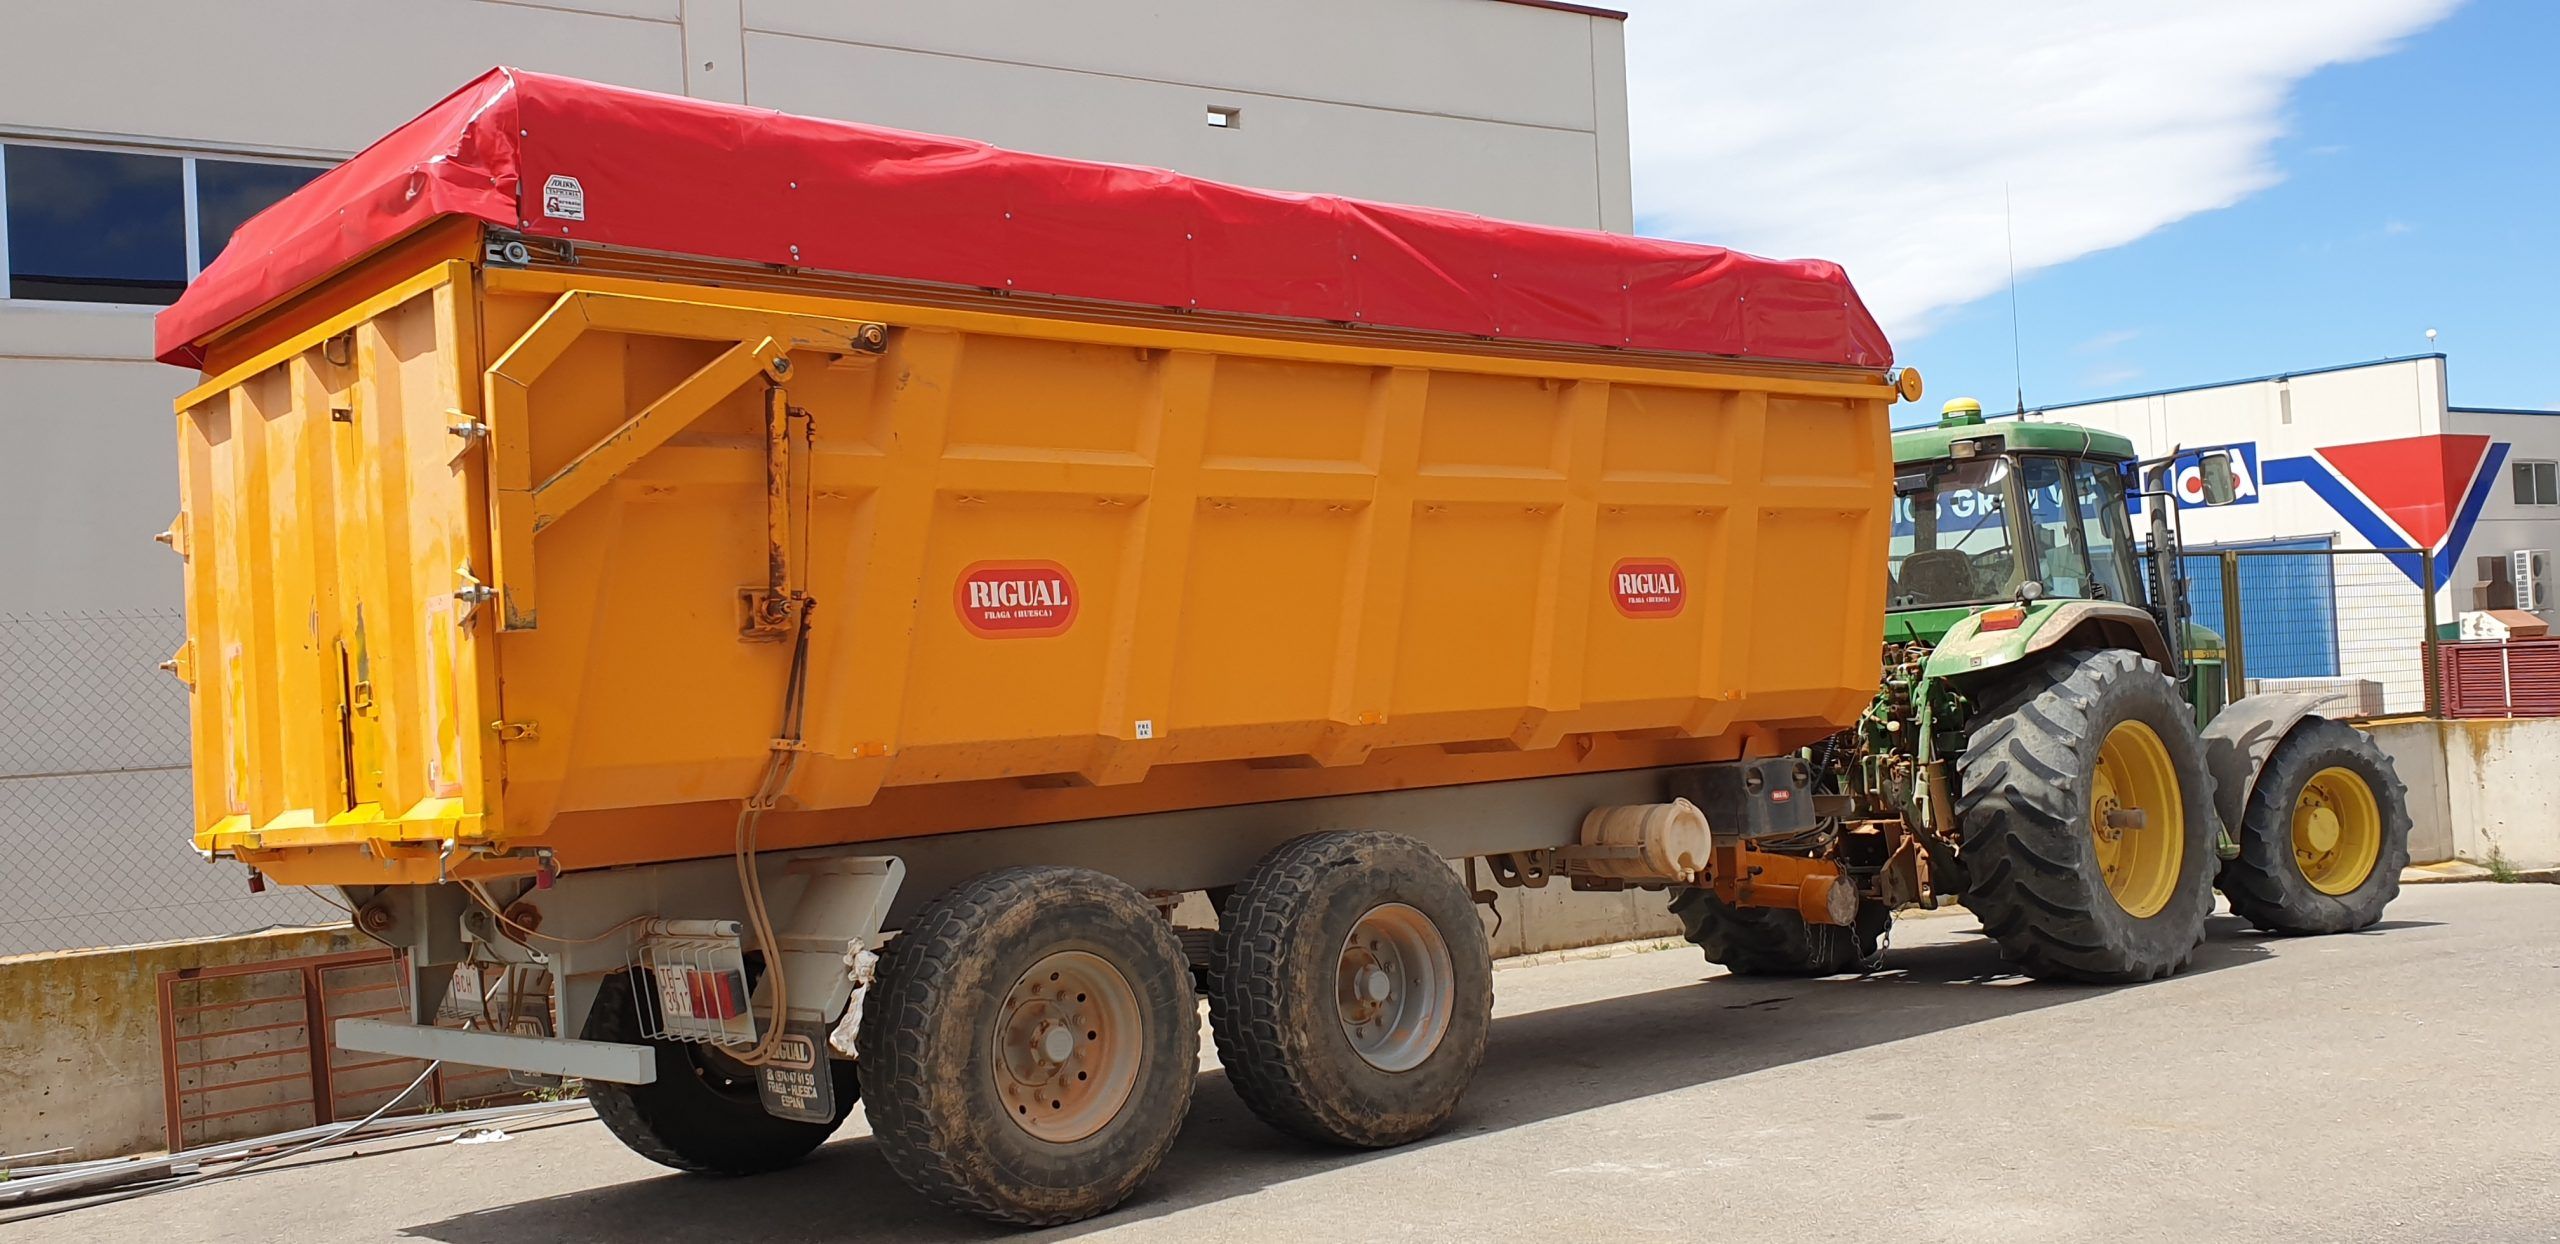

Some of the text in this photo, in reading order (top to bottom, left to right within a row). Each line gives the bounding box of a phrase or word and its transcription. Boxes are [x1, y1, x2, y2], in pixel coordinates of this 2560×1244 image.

[1618, 573, 1680, 595] RIGUAL
[969, 580, 1068, 608] RIGUAL
[984, 610, 1052, 619] FRAGA (HUESCA)
[791, 1084, 818, 1099] HUESCA
